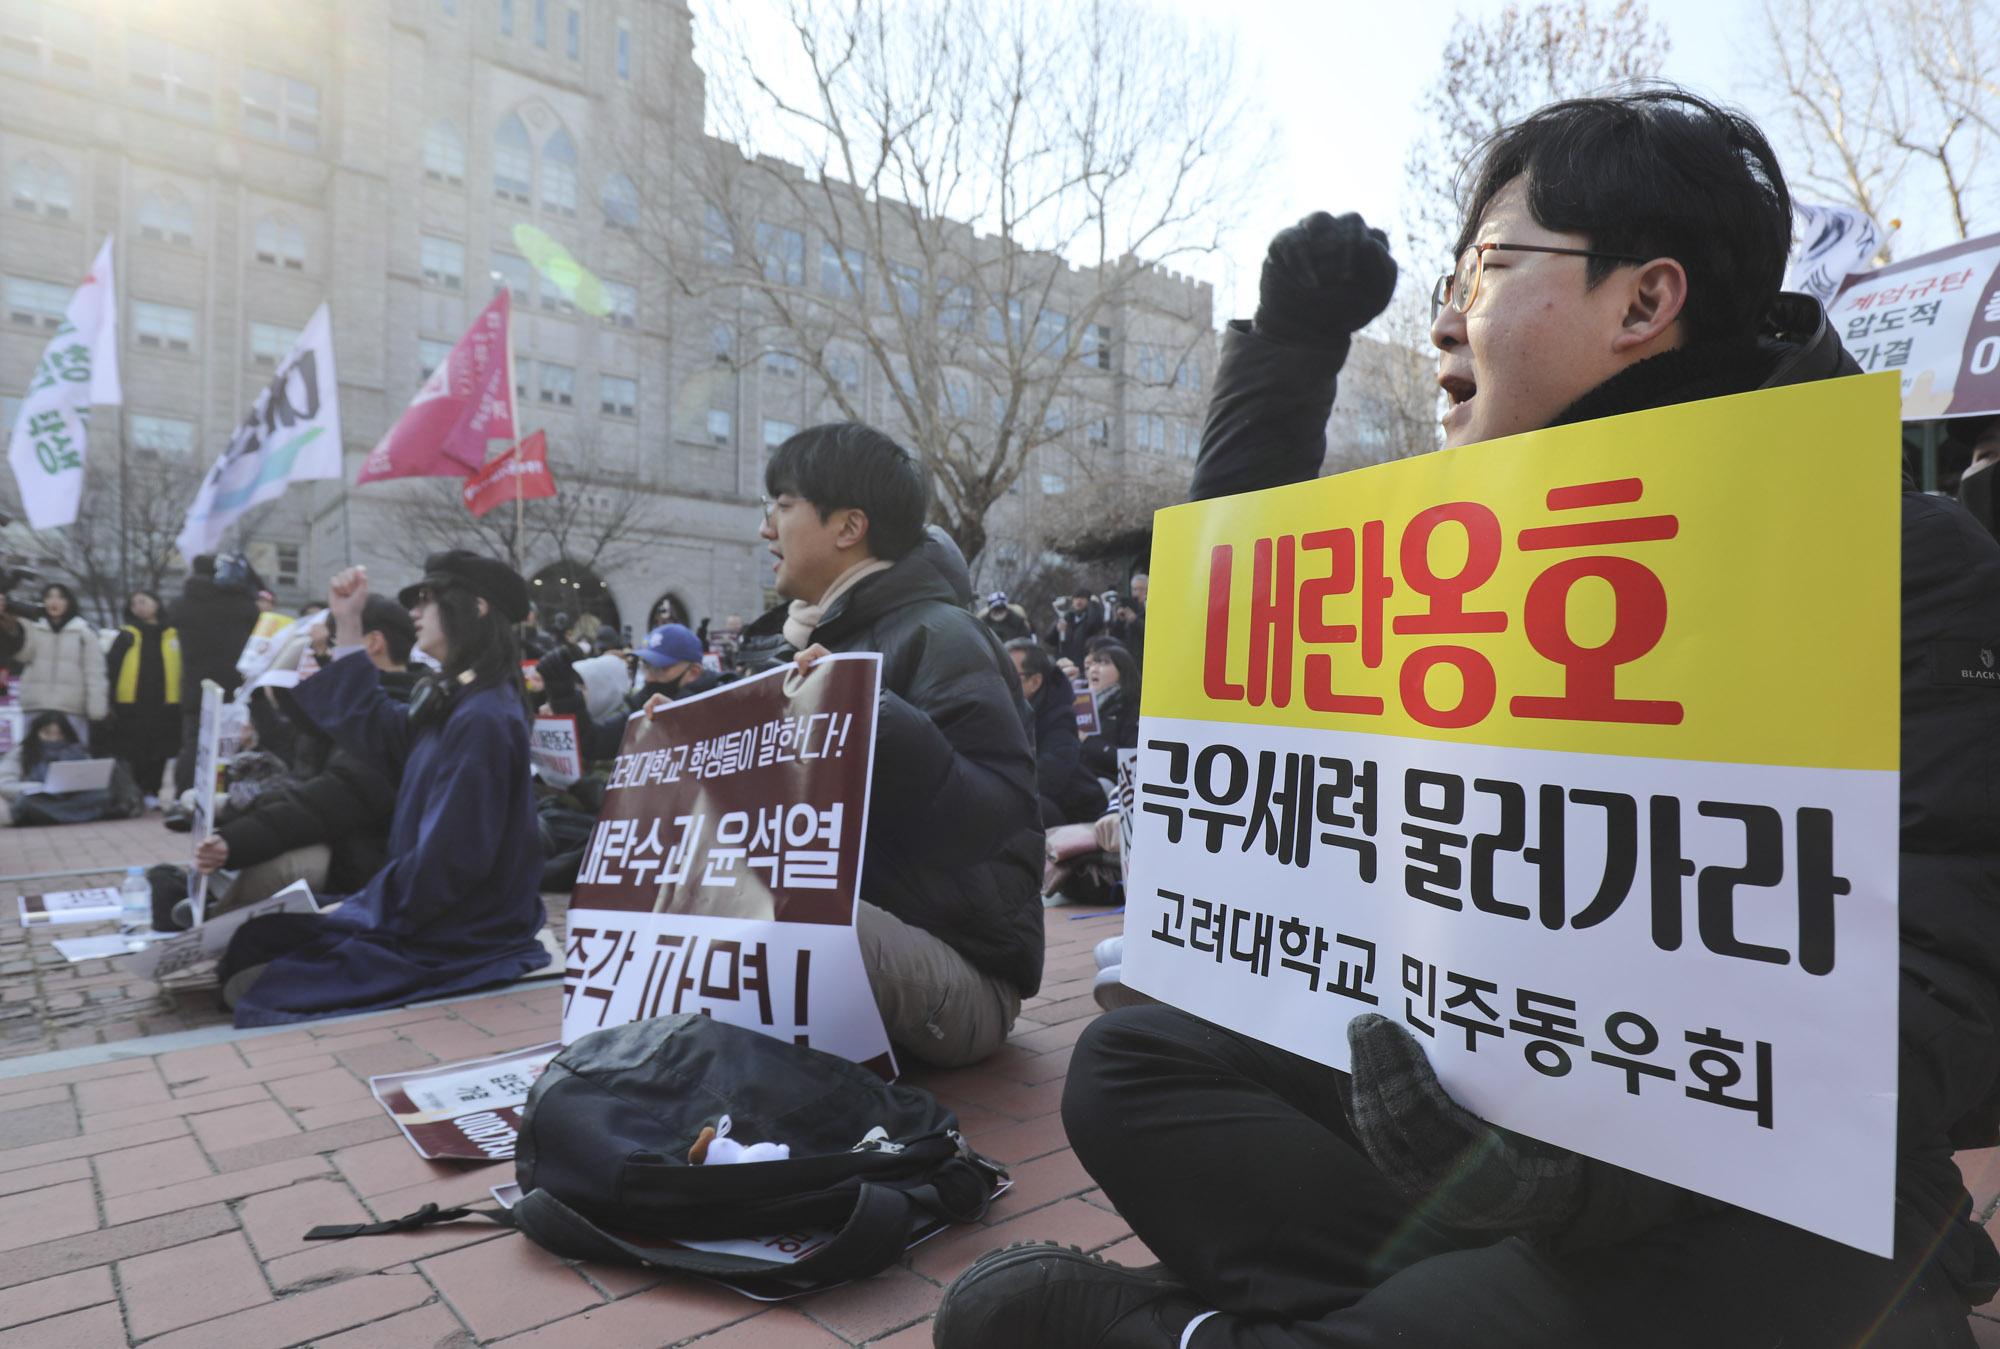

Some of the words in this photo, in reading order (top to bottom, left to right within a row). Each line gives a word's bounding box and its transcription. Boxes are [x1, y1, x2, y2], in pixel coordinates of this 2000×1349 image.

[1846, 268, 1974, 311] 계엄규탄
[1846, 299, 1942, 340] 압도적
[1853, 337, 1913, 371] 가결
[1203, 477, 1685, 729] 내란옹호
[1961, 670, 1995, 680] BLACK
[688, 726, 758, 779] 학생들이
[758, 712, 852, 767] 말한다!
[576, 814, 705, 885] 내란수괴
[701, 803, 844, 889] 윤석열
[1142, 739, 1377, 883] 극우세력
[1400, 767, 1851, 976] 물러가라
[565, 928, 636, 1027] 즉각
[630, 934, 811, 1048] 파면!
[1151, 888, 1378, 1006] 고려대학교
[1401, 953, 1773, 1130] 민주동우회
